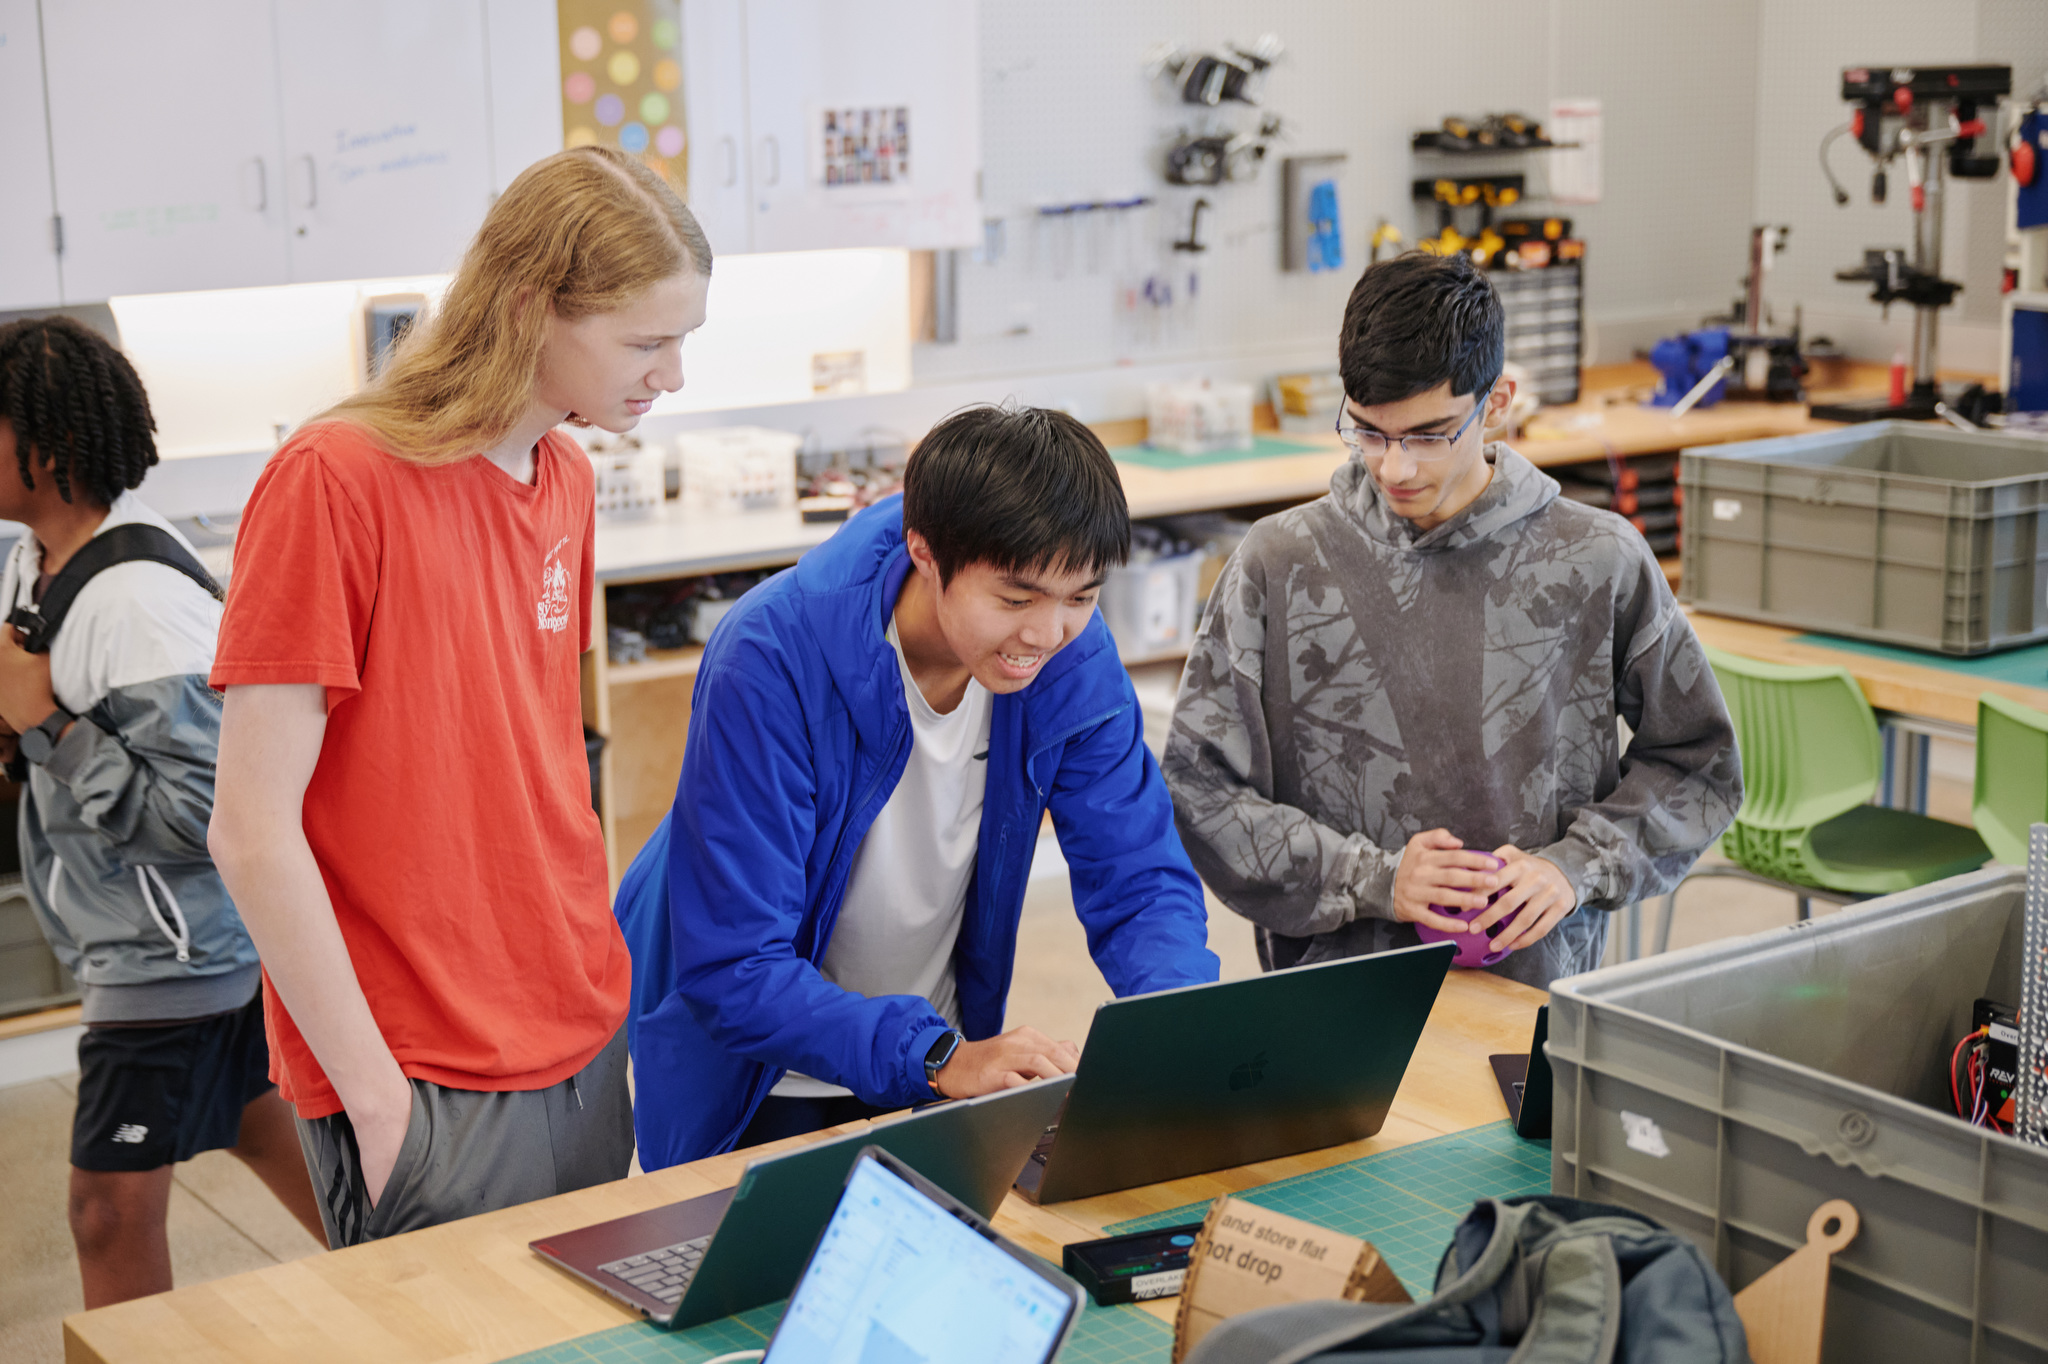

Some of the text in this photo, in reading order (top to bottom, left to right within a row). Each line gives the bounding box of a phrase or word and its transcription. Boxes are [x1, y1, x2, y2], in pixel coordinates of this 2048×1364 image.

[1989, 1067, 2015, 1084] REV
[1221, 1214, 1329, 1261] and store flat
[1205, 1240, 1234, 1263] not
[1237, 1250, 1284, 1285] drop
